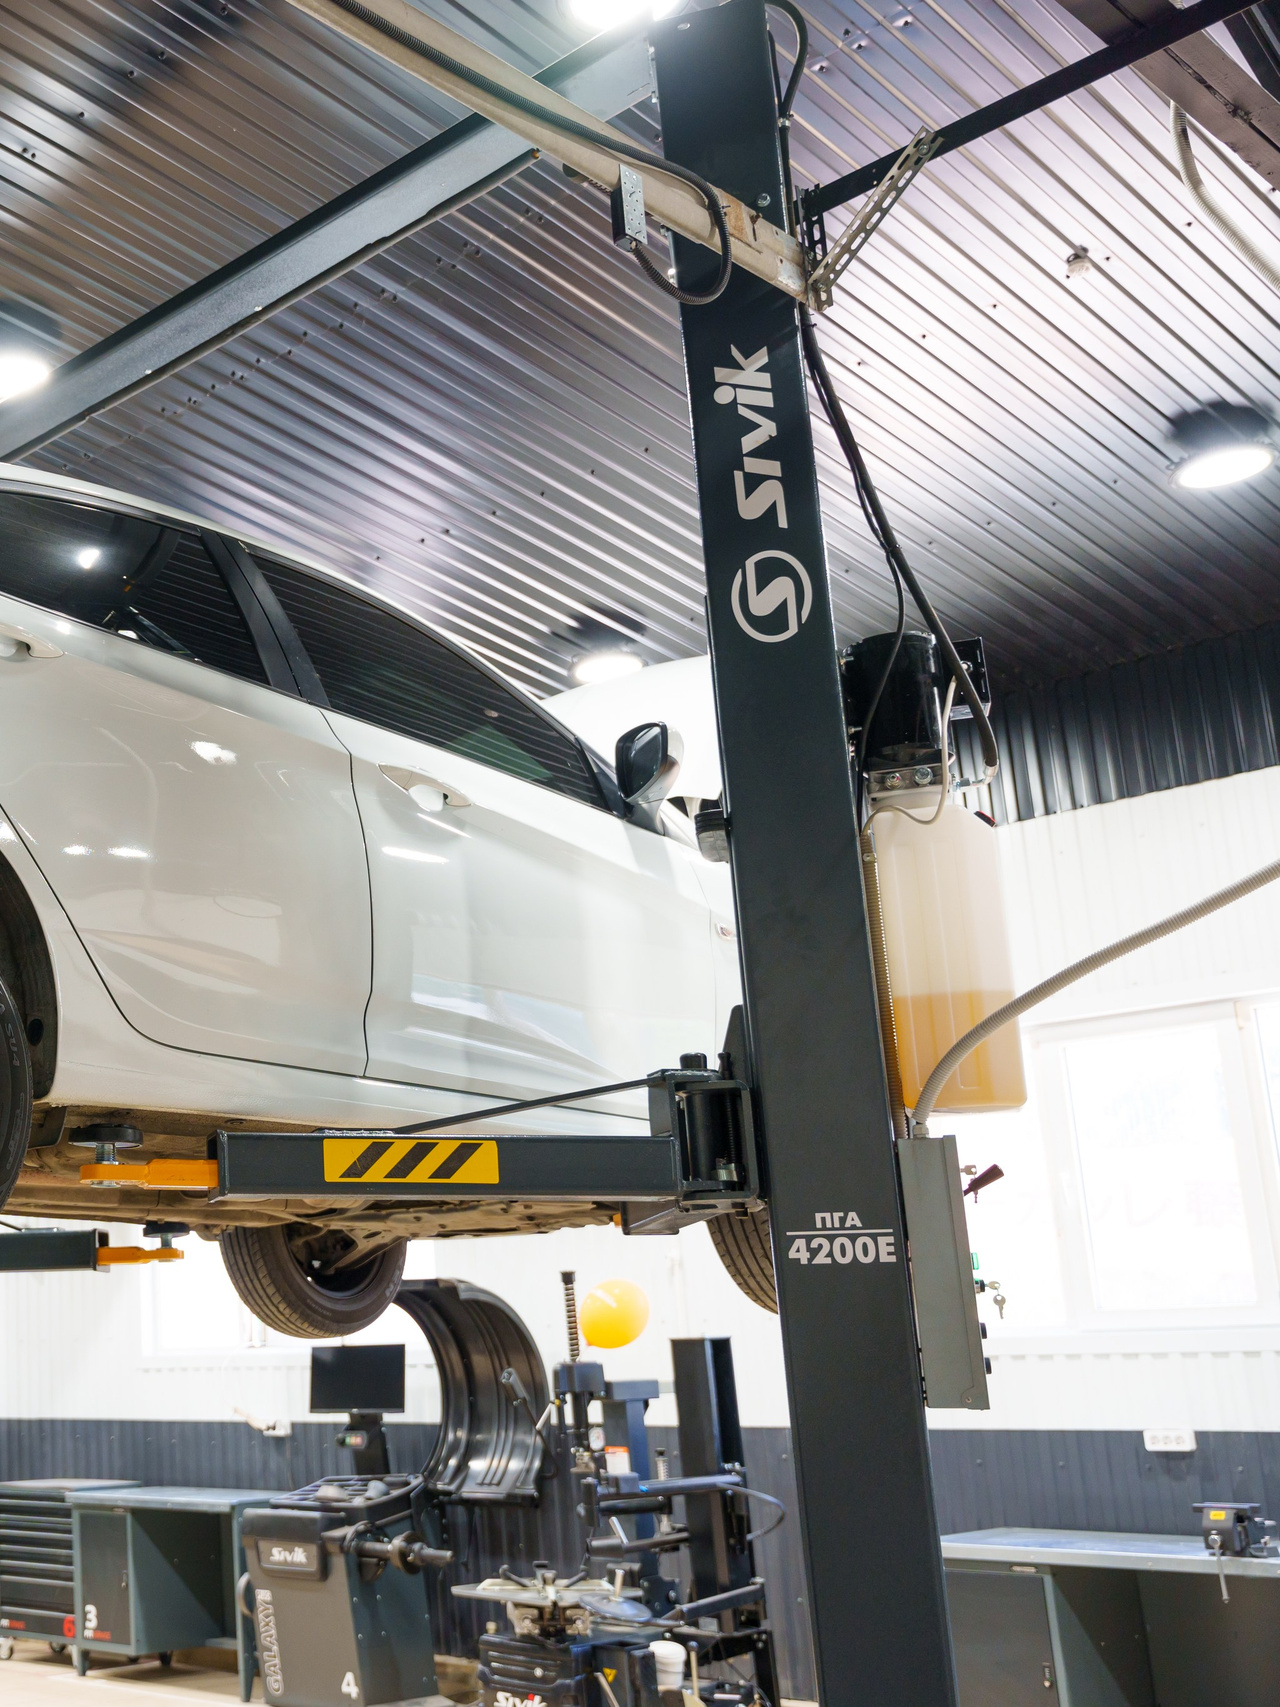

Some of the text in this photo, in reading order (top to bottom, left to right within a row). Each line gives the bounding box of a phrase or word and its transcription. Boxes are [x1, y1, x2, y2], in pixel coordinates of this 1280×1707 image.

[714, 344, 788, 529] Sivik
[814, 1211, 863, 1229] ПГА
[269, 1546, 308, 1564] Sivik
[63, 1616, 75, 1638] 6
[84, 1604, 98, 1630] 3
[258, 1600, 284, 1697] GALAXY
[341, 1671, 360, 1699] 4
